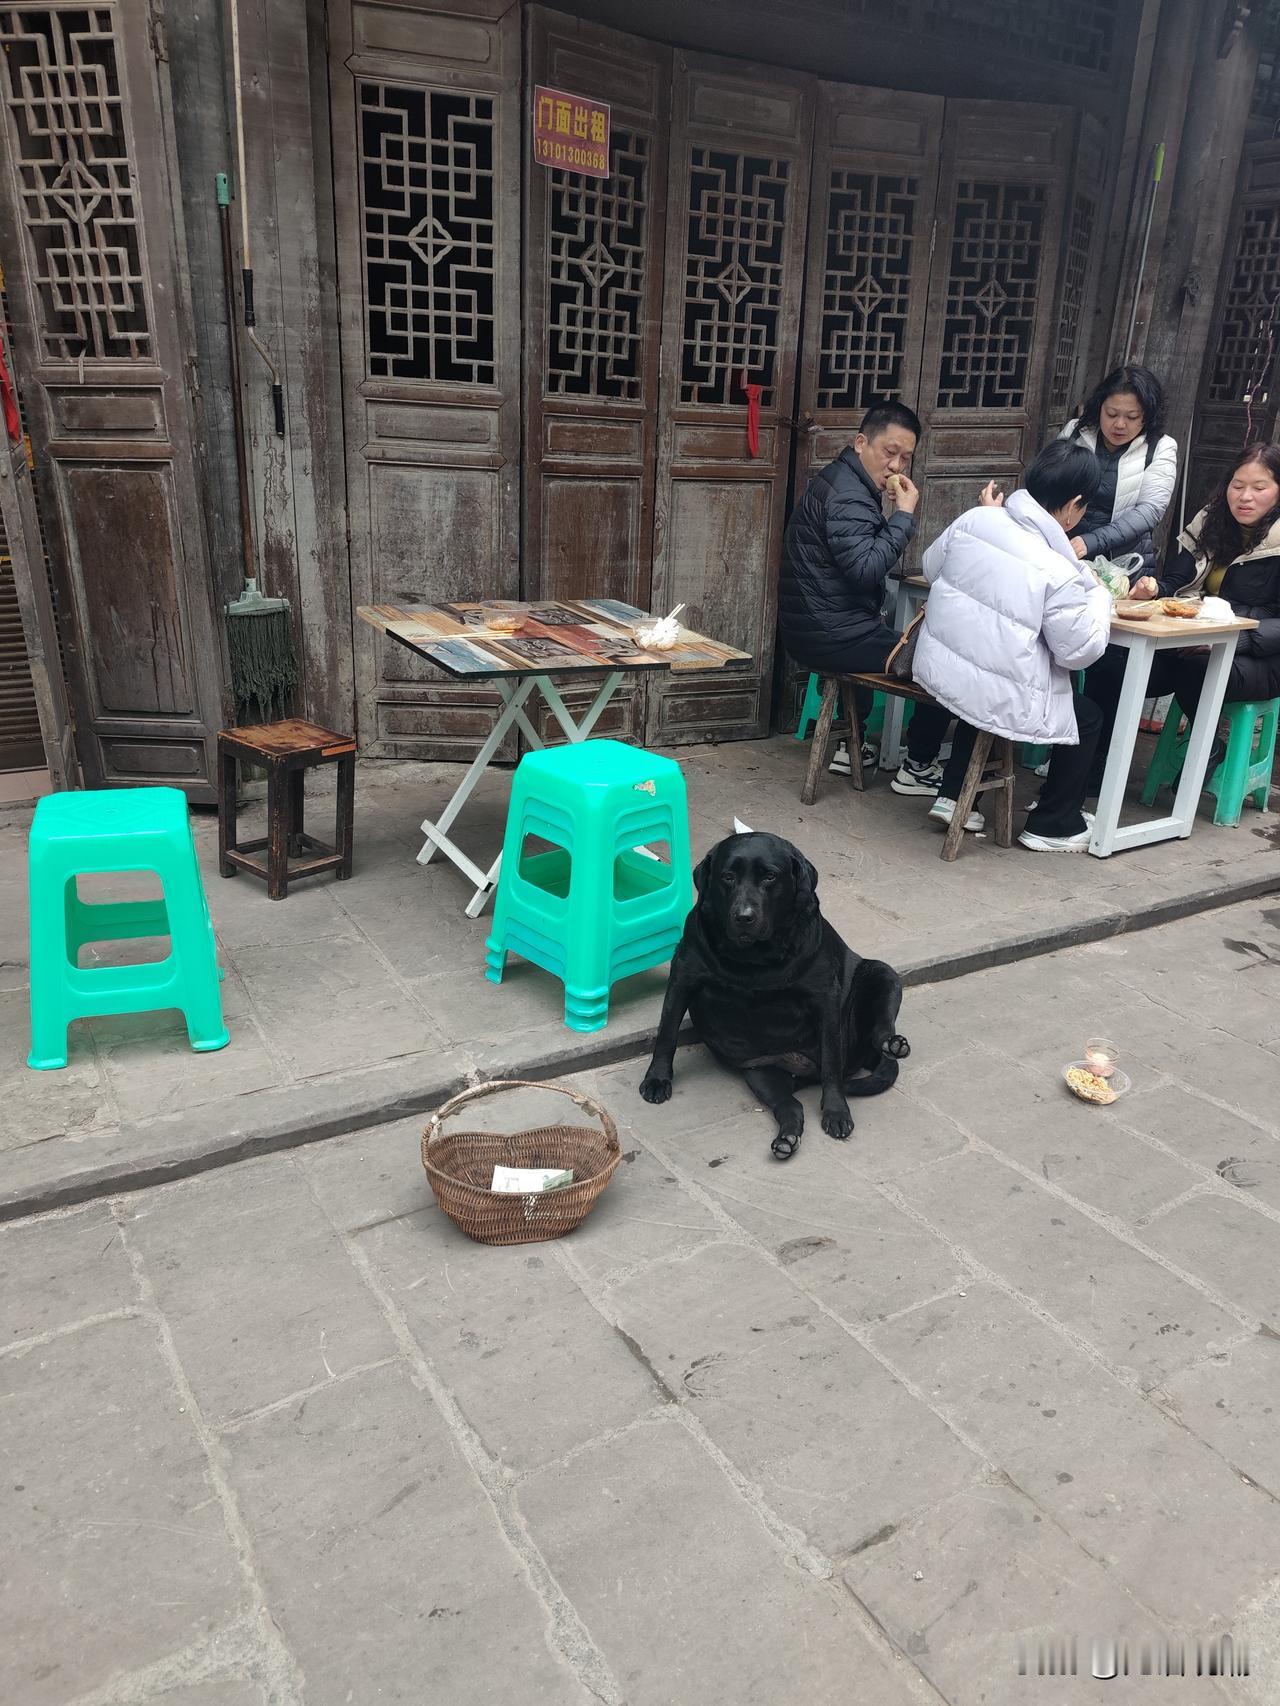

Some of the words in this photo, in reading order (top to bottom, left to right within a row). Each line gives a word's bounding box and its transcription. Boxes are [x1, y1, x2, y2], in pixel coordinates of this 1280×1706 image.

[538, 95, 606, 143] 门面出租
[537, 138, 605, 170] 13101300368
